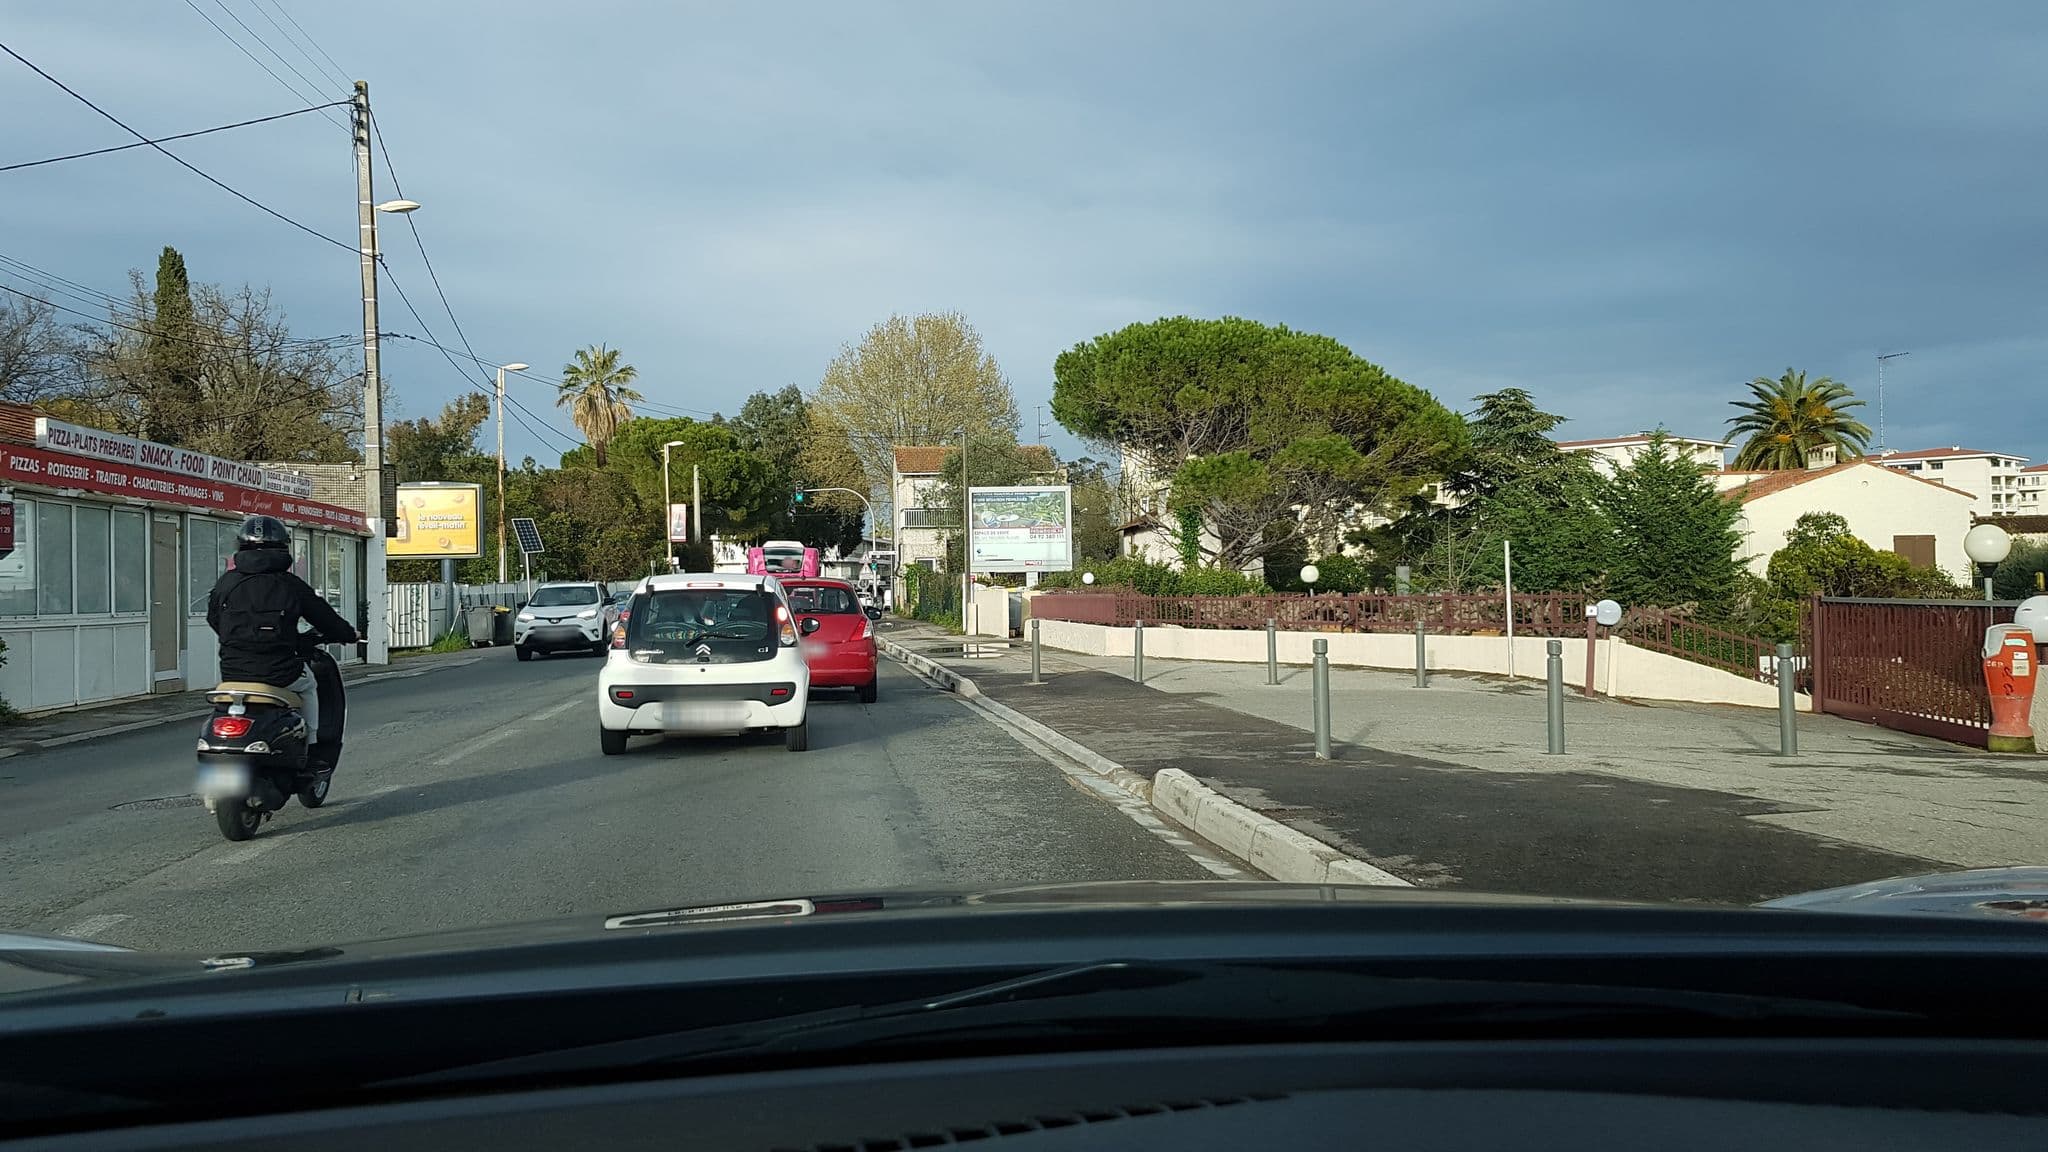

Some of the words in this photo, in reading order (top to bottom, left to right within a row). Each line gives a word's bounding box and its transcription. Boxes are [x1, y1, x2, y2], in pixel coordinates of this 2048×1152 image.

[140, 444, 174, 467] SNACK
[180, 453, 205, 474] FOOD
[211, 460, 237, 479] POINT
[237, 466, 262, 486] CHAUD
[10, 455, 40, 473] PIZZAS
[47, 462, 89, 480] ROTISSERIE
[95, 470, 128, 487] TRAITEUR
[132, 476, 175, 494] CHARCUTERIES
[177, 484, 208, 500] FROMAGES
[212, 490, 224, 502] VINS
